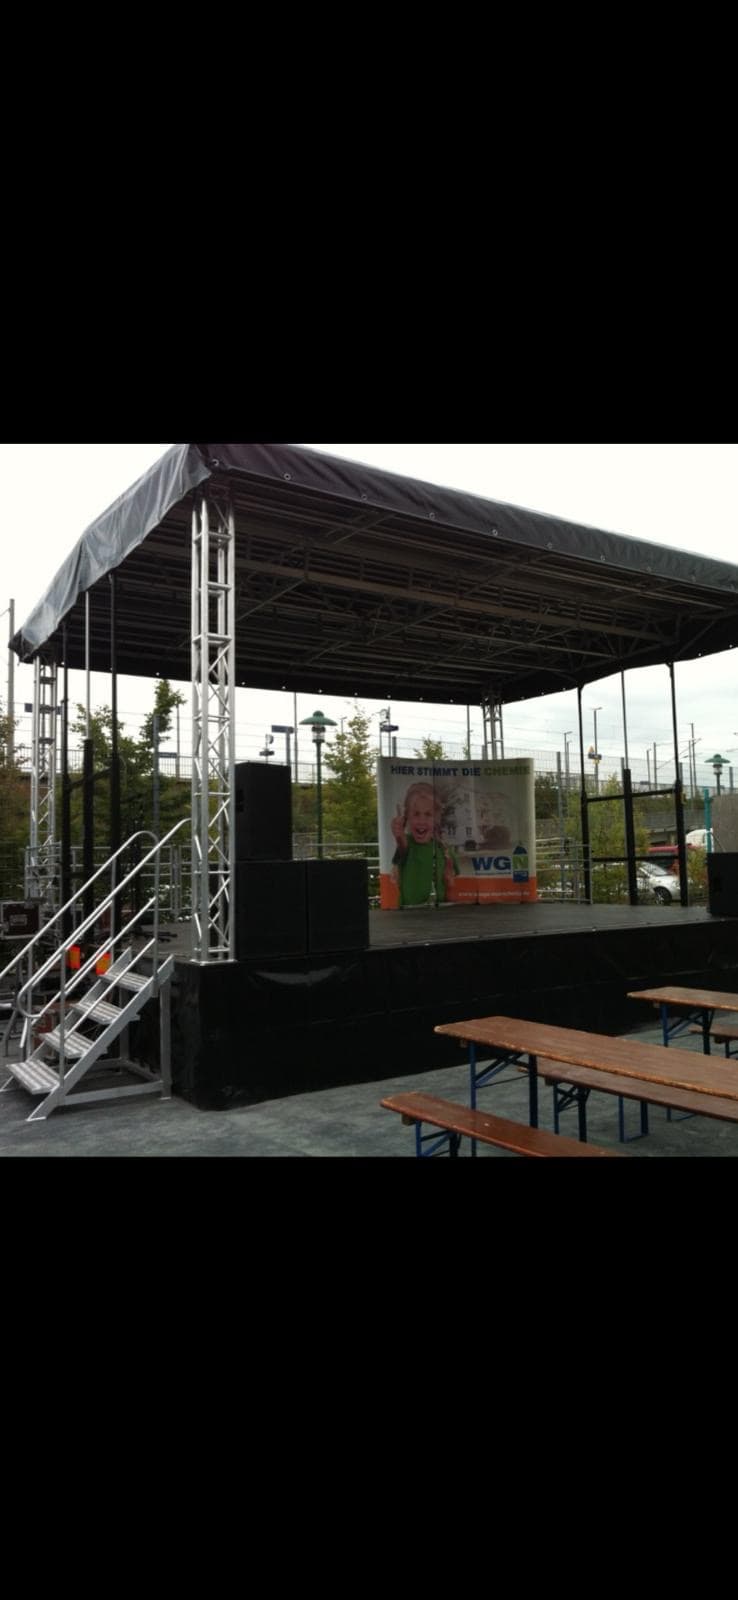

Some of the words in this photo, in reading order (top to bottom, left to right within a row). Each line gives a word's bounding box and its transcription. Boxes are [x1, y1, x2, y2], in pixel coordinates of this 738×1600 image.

[391, 766, 414, 775] HIER
[417, 767, 458, 776] STIMMT
[462, 767, 481, 776] DIE
[485, 766, 530, 775] CHEMIE
